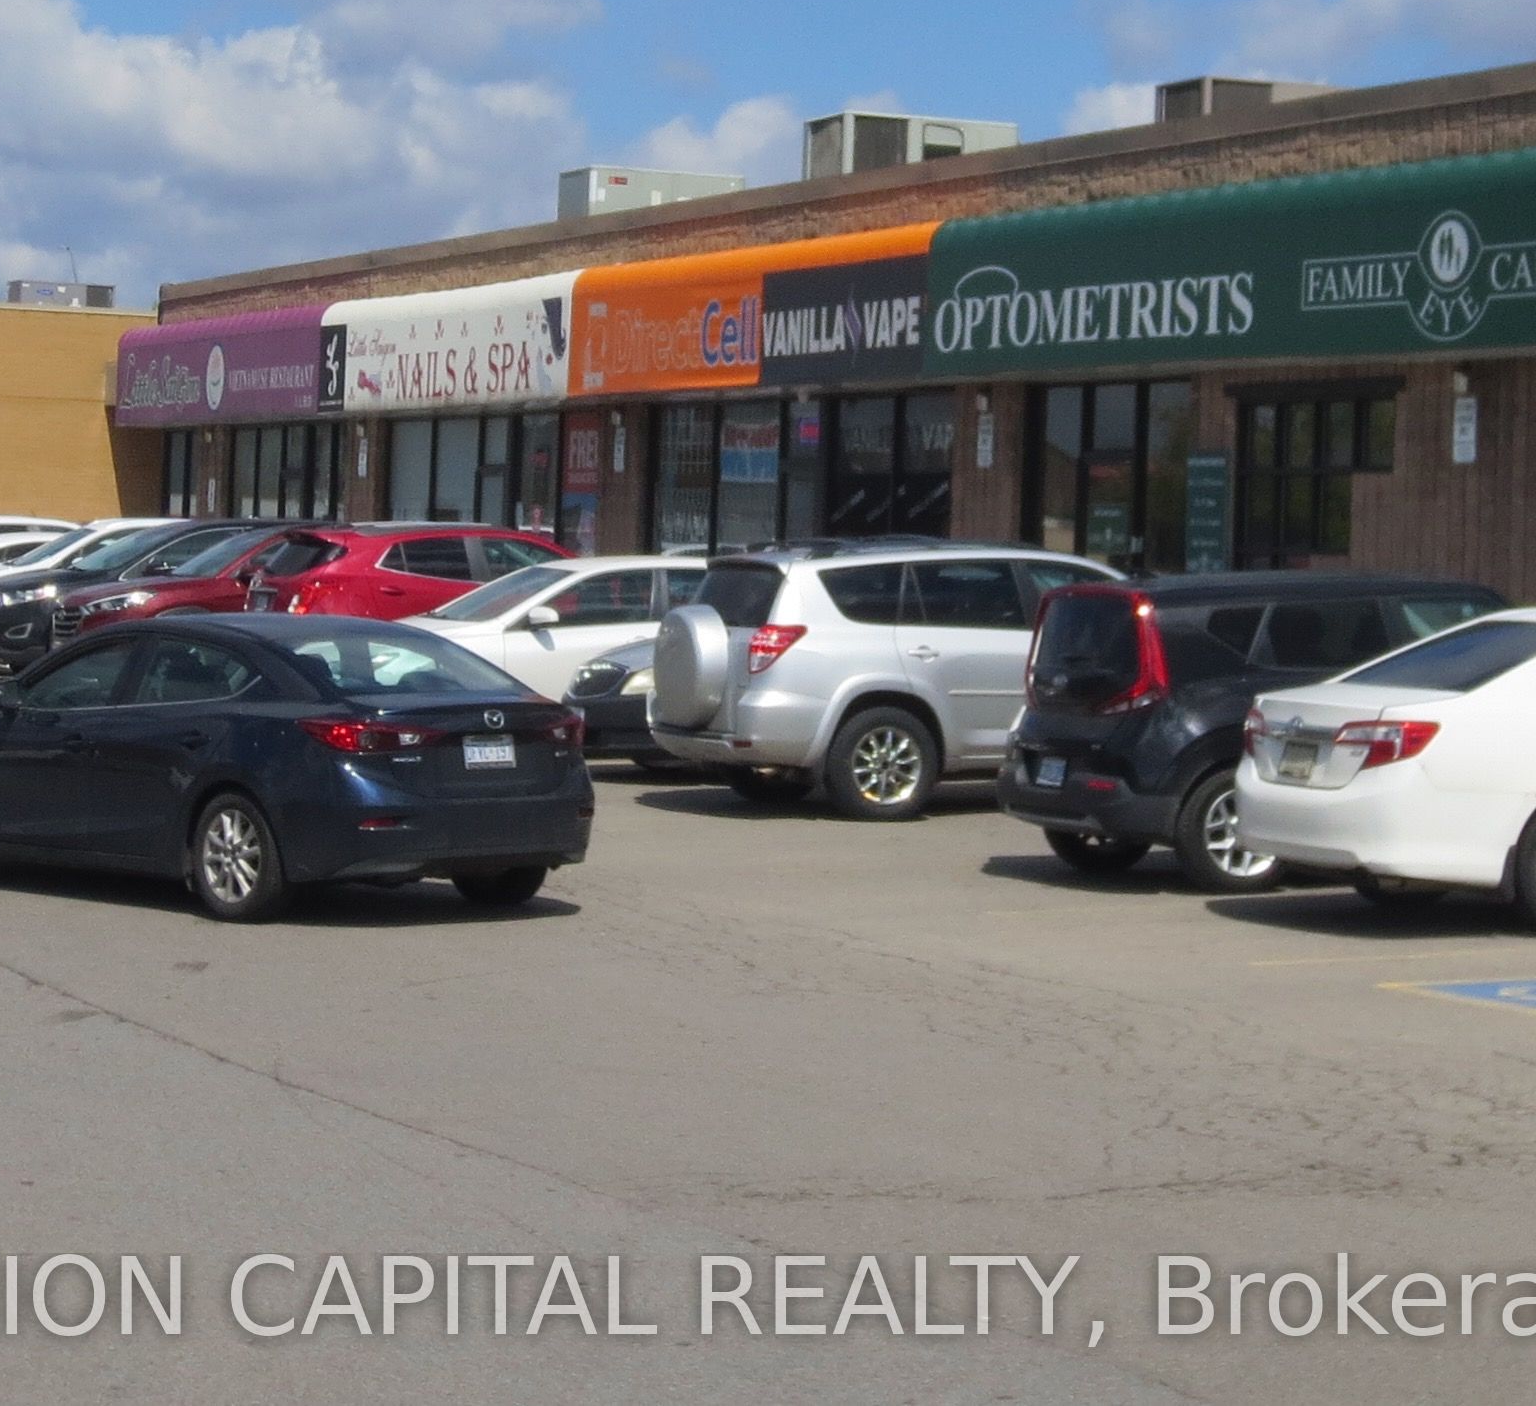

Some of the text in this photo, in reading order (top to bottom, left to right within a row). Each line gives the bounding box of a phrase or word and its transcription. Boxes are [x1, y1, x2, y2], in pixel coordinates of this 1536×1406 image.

[764, 295, 922, 358] VANILLA VAPE
[934, 272, 1255, 354] OPTOMETRISTS
[1307, 261, 1411, 303] FAMILY
[1418, 285, 1480, 333] EYE
[395, 341, 531, 400] NAILS & SPA
